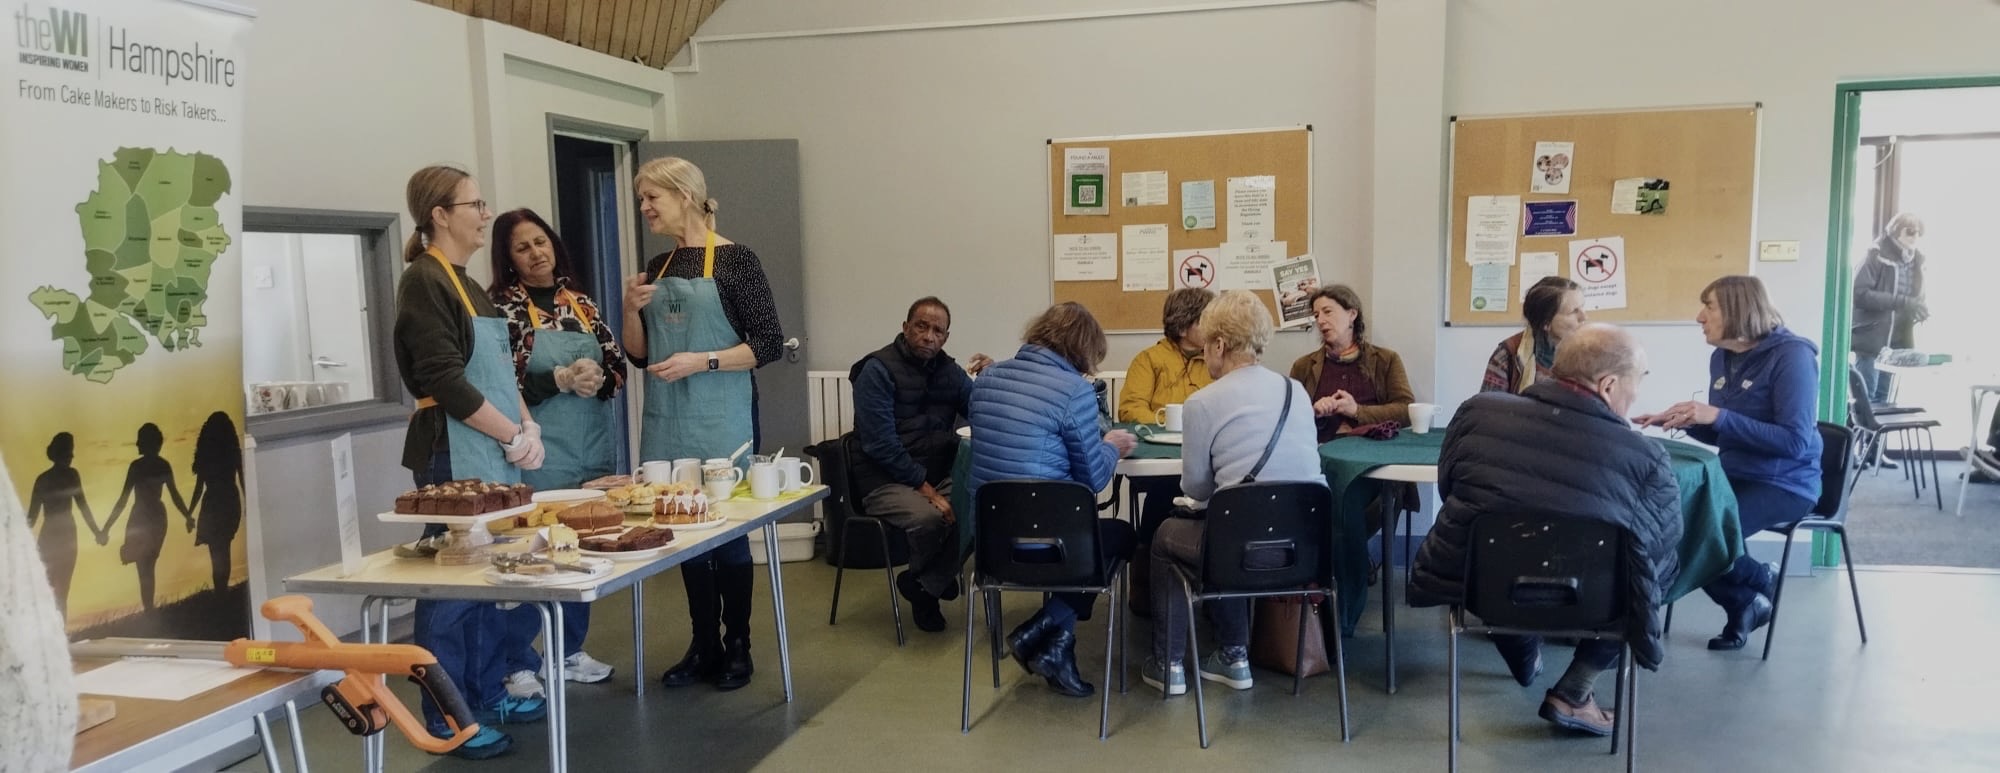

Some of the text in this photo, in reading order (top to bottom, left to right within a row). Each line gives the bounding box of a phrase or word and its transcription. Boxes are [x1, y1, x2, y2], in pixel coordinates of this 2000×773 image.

[19, 52, 89, 73] INSPIRING WOMEN
[109, 26, 235, 87] Hampshire
[19, 79, 56, 102] From
[61, 84, 91, 106] Cake
[94, 89, 137, 112] Makers
[141, 96, 151, 113] to
[155, 97, 178, 117] Risk
[1280, 267, 1293, 278] SAY
[1294, 265, 1309, 274] YES
[669, 303, 681, 313] WI
